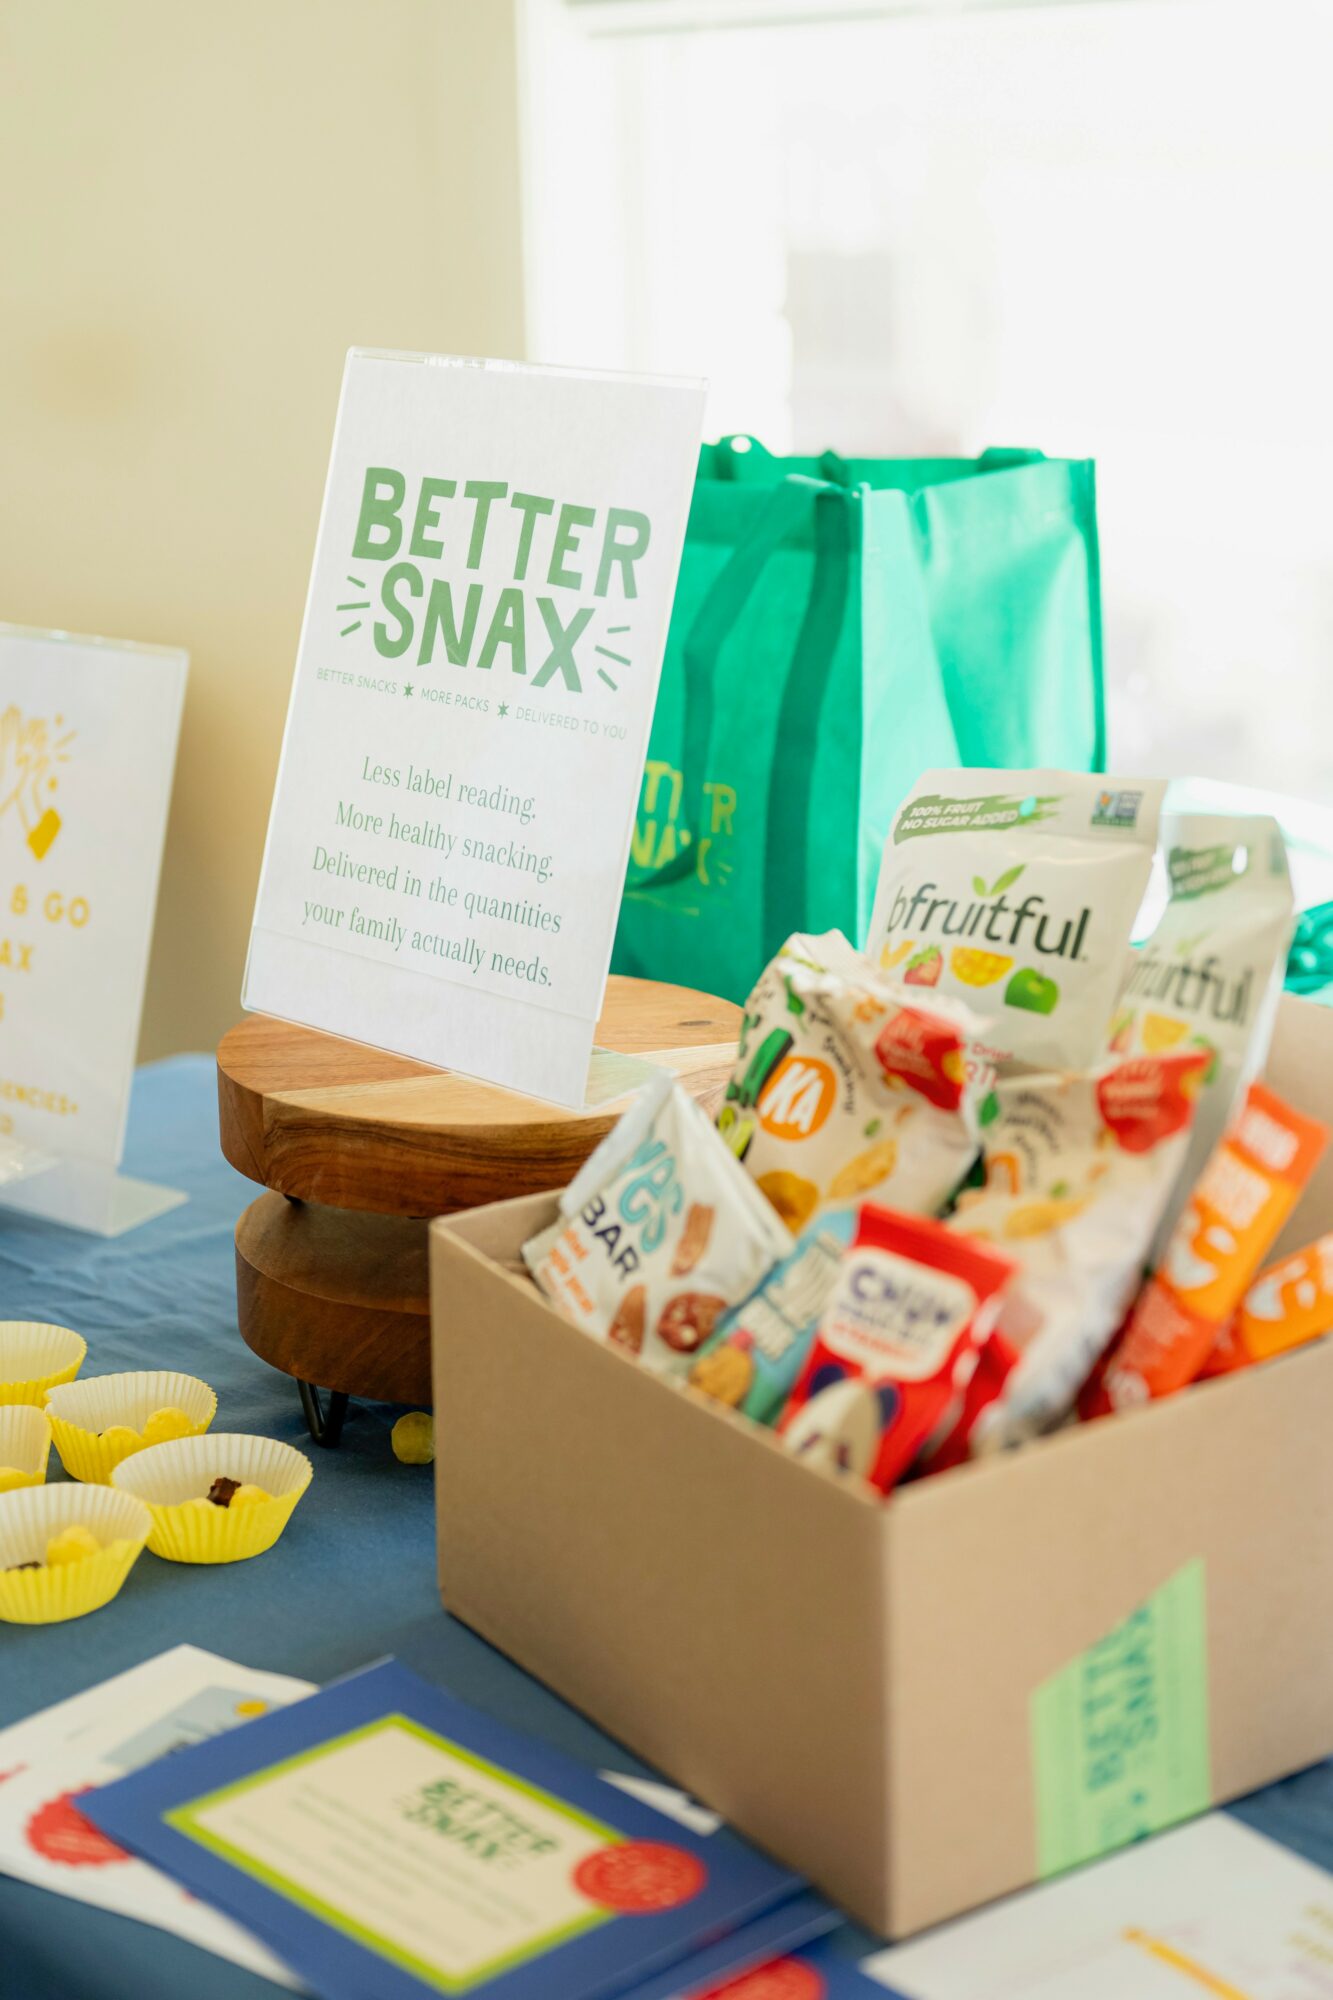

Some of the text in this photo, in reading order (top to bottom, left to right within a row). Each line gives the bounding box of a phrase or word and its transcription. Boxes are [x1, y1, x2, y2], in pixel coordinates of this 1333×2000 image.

[352, 467, 651, 599] BETTER
[373, 562, 596, 693] SNAX
[316, 667, 628, 741] BETTER SNACKS MORE PACKS DELIVERED TO YOU
[362, 756, 537, 826] Less label reading.
[901, 809, 1019, 831] NO SUGAR ADDED
[910, 801, 985, 818] 100% FRUIT
[335, 800, 554, 884] More healthy snacking.
[43, 890, 91, 929] GO
[313, 846, 562, 934] Delivered in the quantities
[302, 901, 552, 987] your family actually needs.
[580, 1197, 641, 1282] BAR
